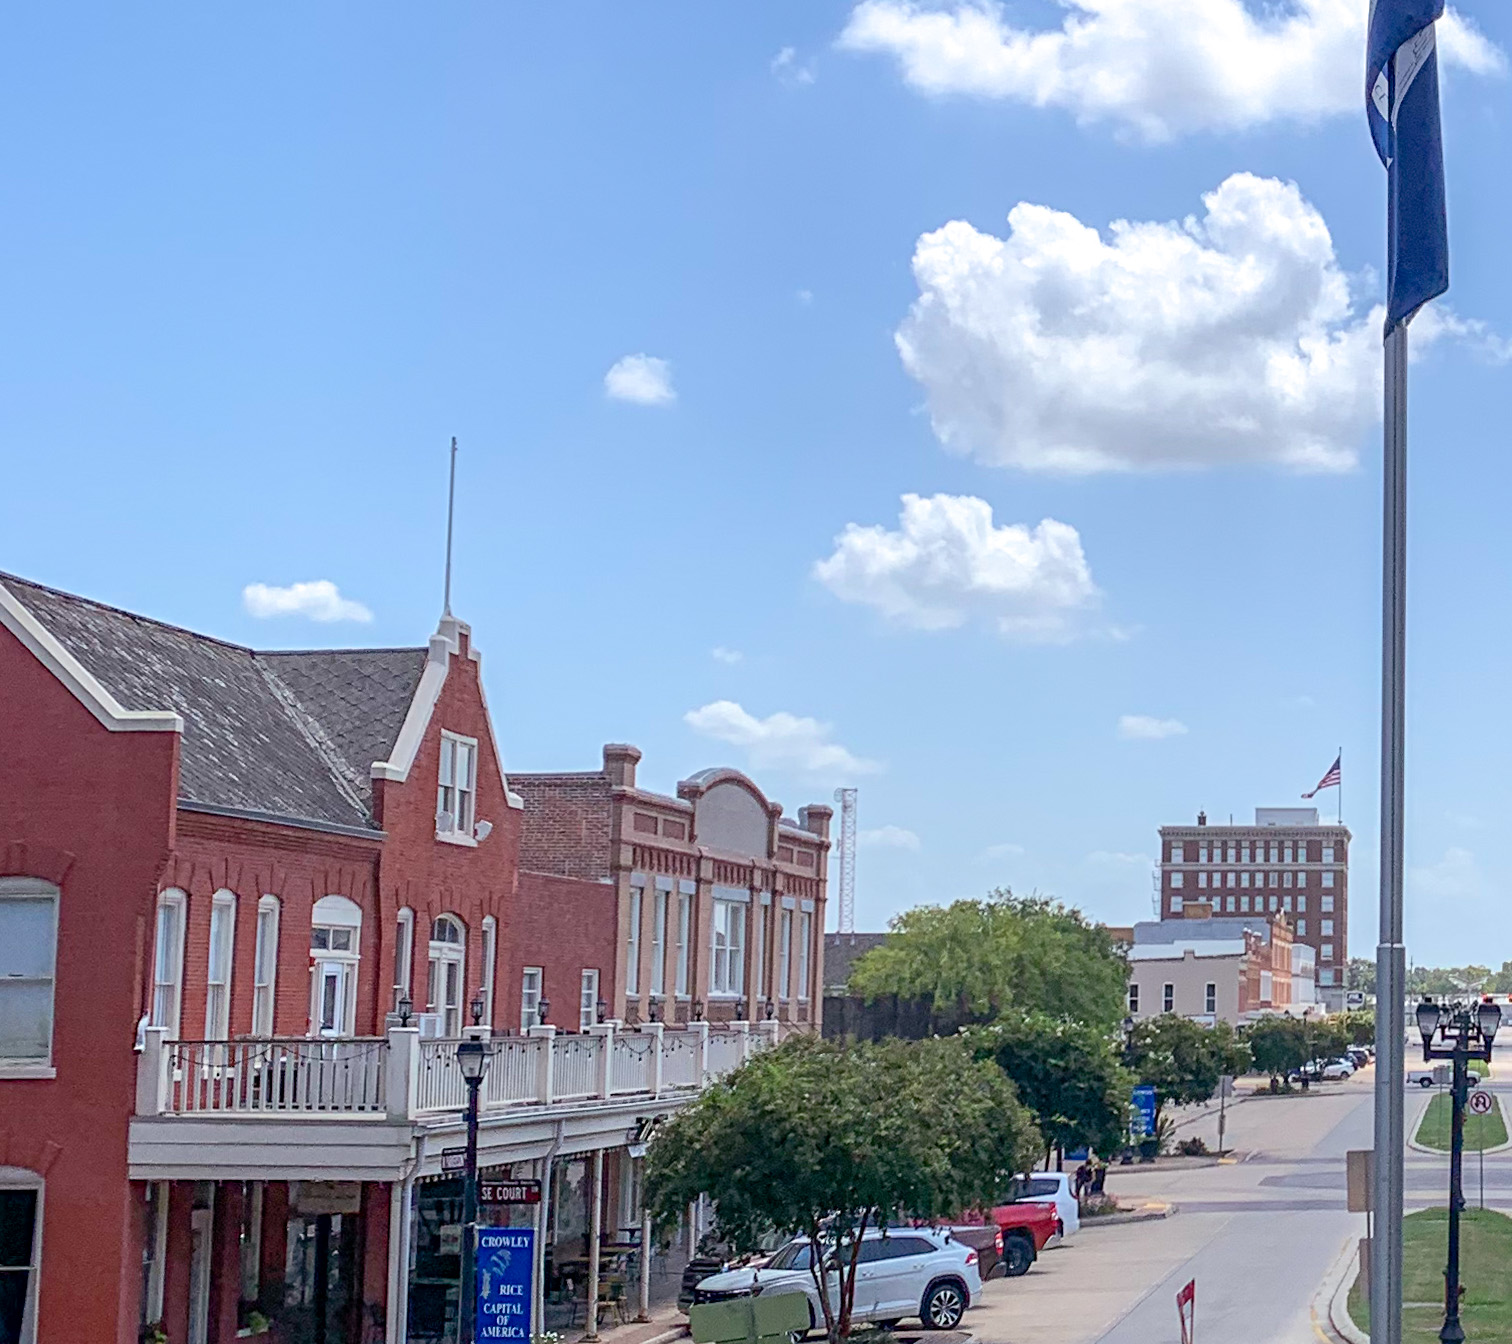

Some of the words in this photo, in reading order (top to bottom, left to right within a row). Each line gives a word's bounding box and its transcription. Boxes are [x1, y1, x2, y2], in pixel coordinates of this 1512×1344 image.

[481, 1187, 493, 1200] SE
[496, 1187, 527, 1200] COURT
[481, 1236, 530, 1248] CROWLEY
[499, 1284, 524, 1296] RICE
[483, 1303, 524, 1314] CAPITAL
[496, 1315, 510, 1326] OF
[480, 1326, 525, 1338] AMERICA
